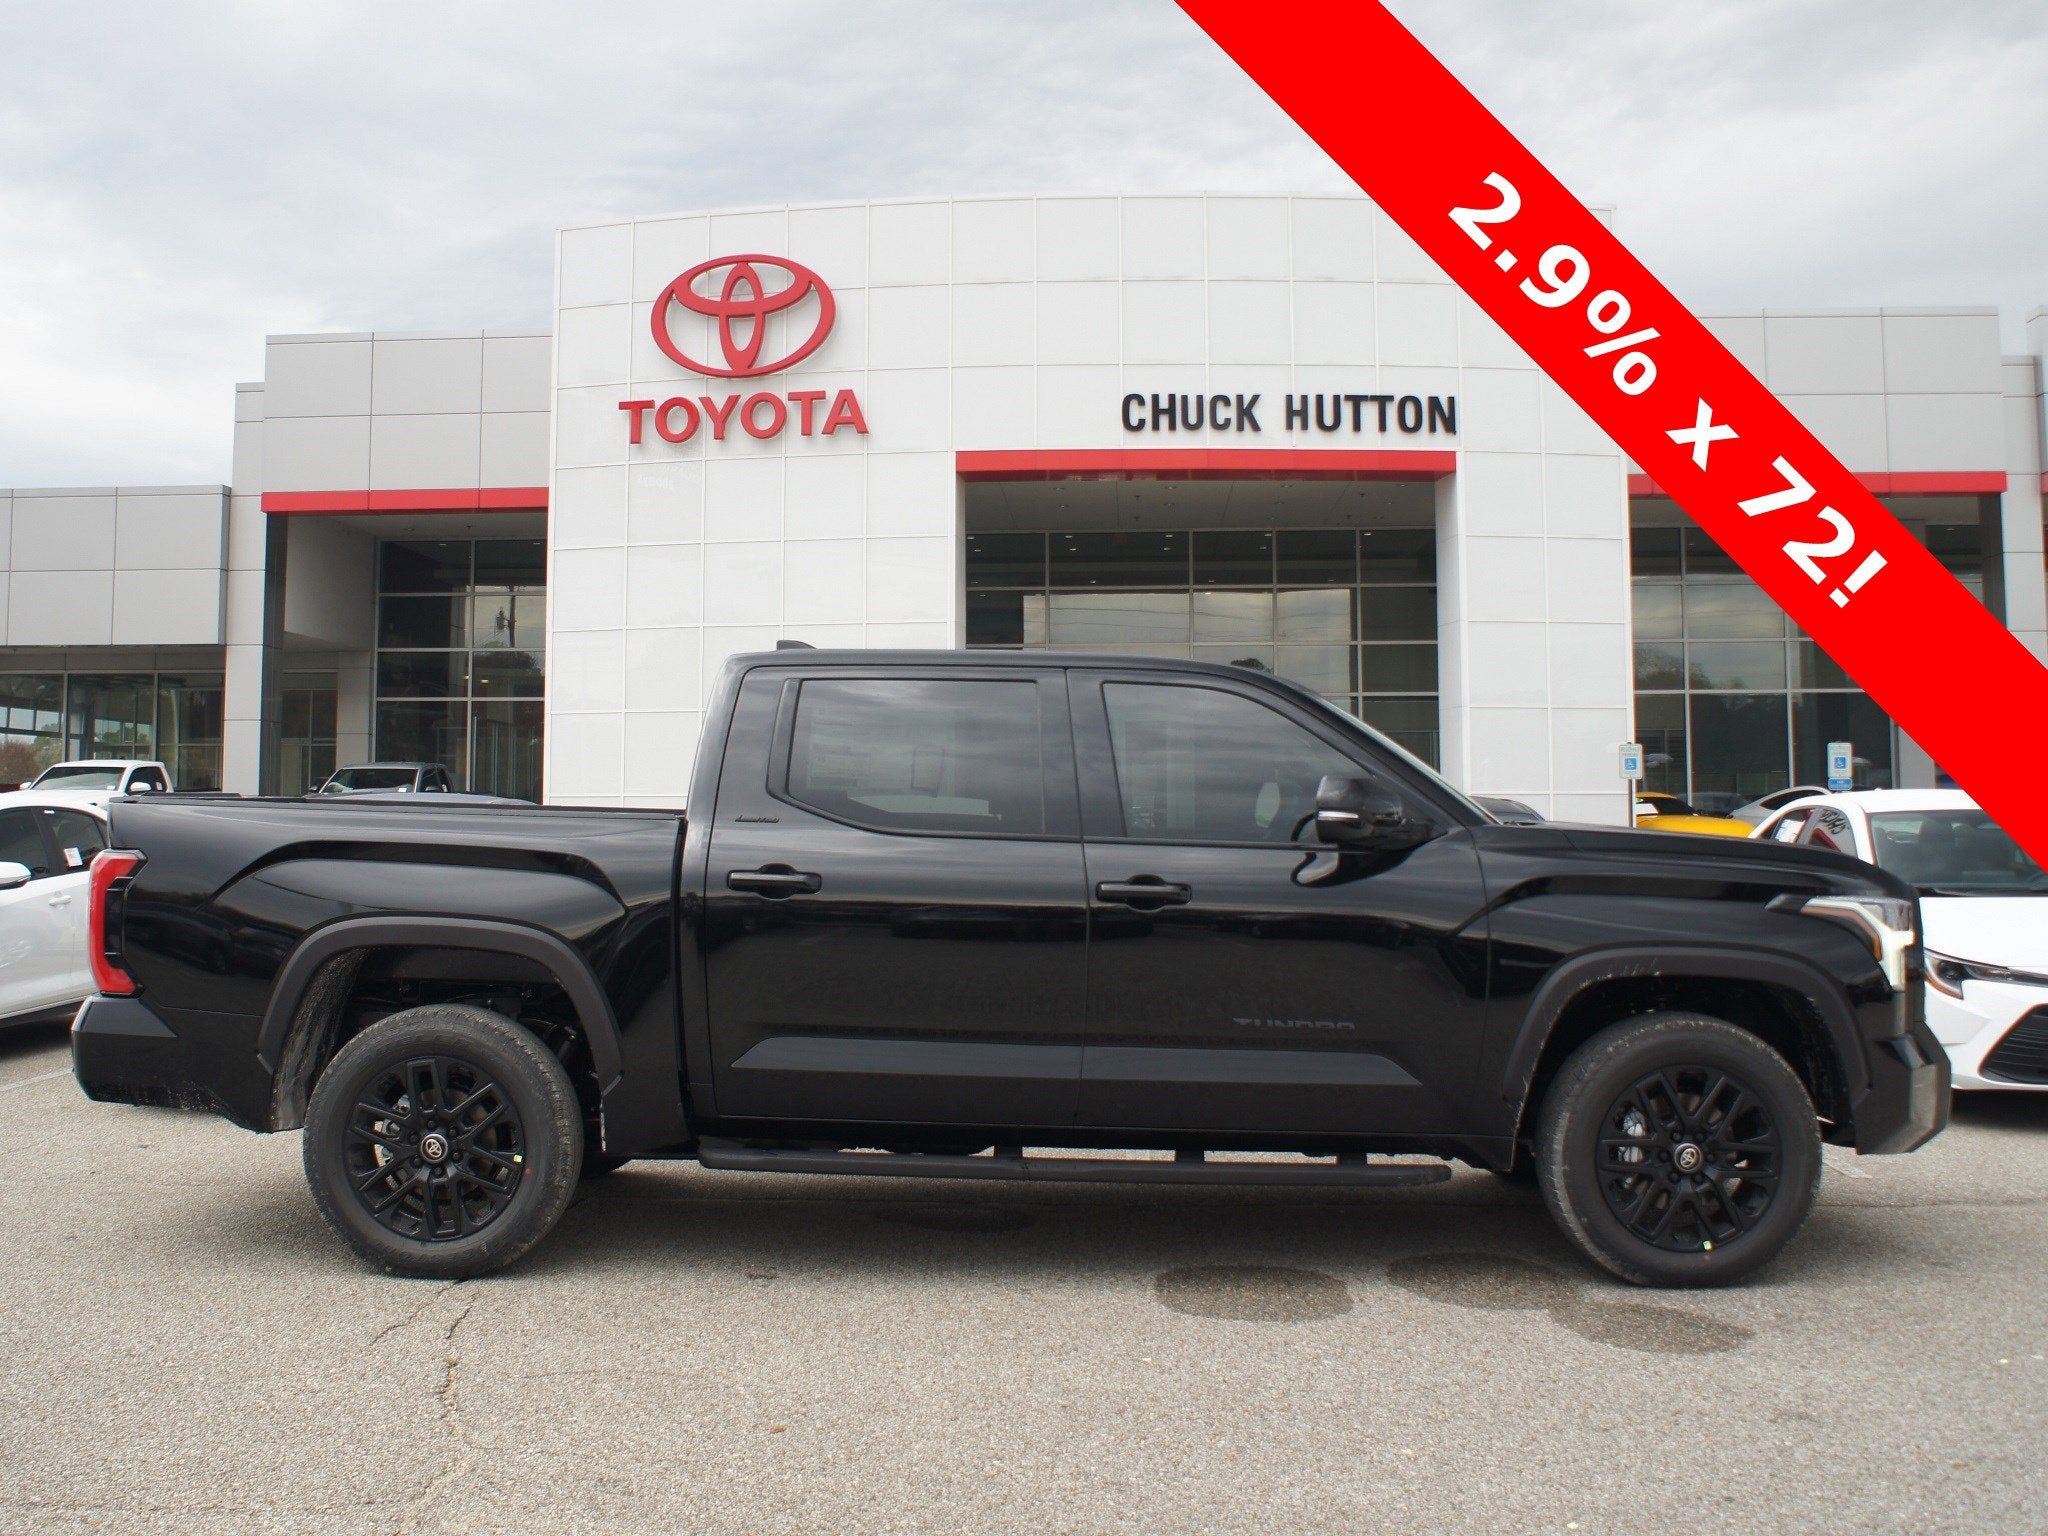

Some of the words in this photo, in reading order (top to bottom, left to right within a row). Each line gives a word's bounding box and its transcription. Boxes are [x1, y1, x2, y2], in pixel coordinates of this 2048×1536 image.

[618, 388, 870, 445] TOYOTA
[1121, 393, 1262, 433] CHUCK
[1285, 394, 1457, 435] HUTTON
